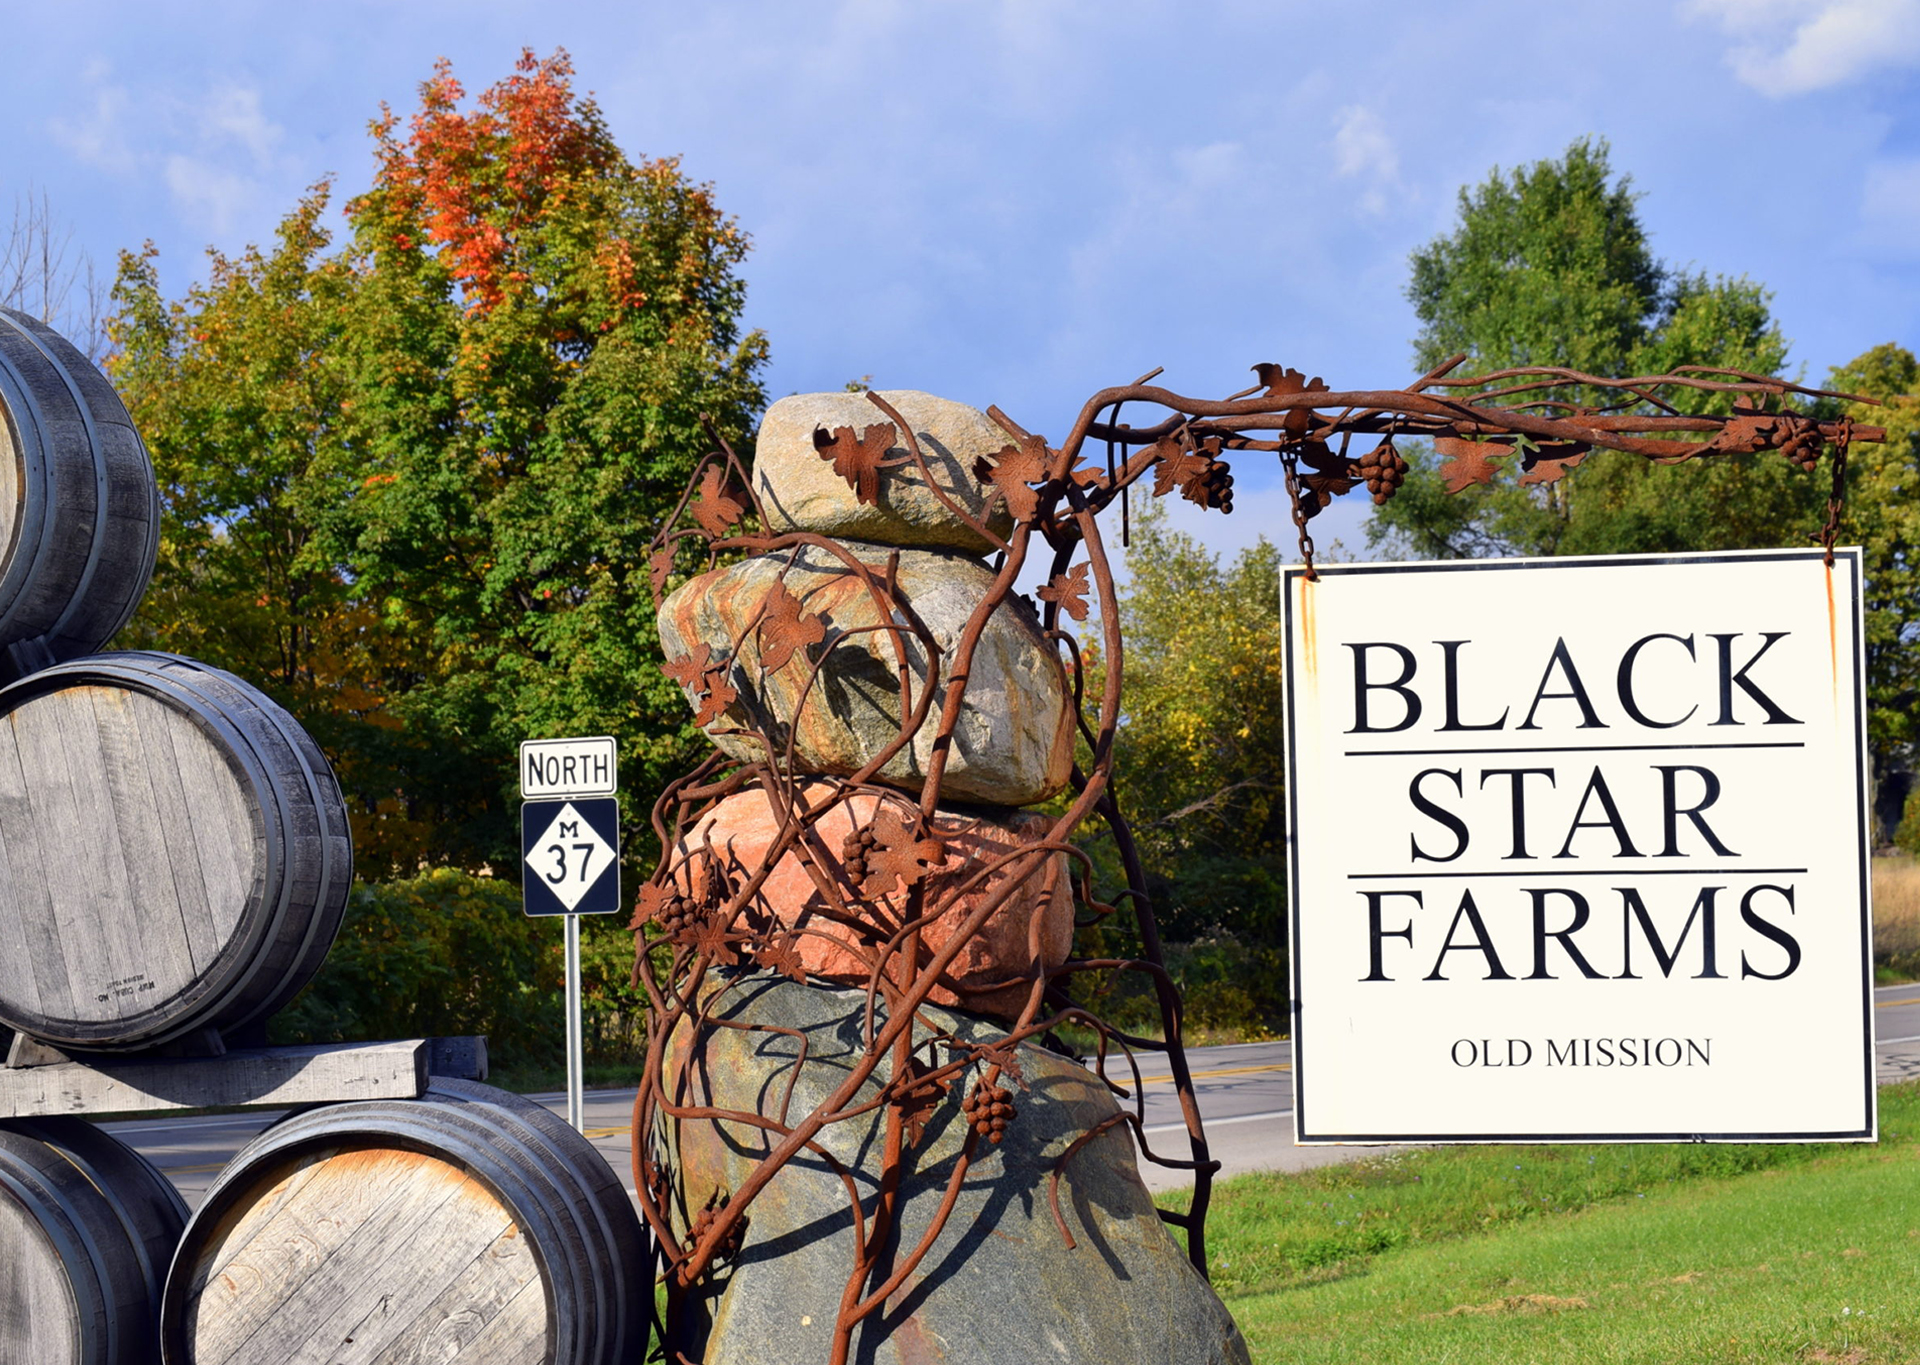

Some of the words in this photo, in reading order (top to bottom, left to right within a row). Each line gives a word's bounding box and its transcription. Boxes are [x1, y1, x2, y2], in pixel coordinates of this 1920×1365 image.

[1341, 631, 1806, 734] BLACK
[528, 752, 608, 787] NORTH
[559, 821, 579, 838] M
[1408, 764, 1742, 864] STAR
[546, 843, 595, 885] 37
[1356, 883, 1802, 983] FARMS
[1450, 1038, 1533, 1068] OLD
[1545, 1037, 1713, 1068] MISSION
